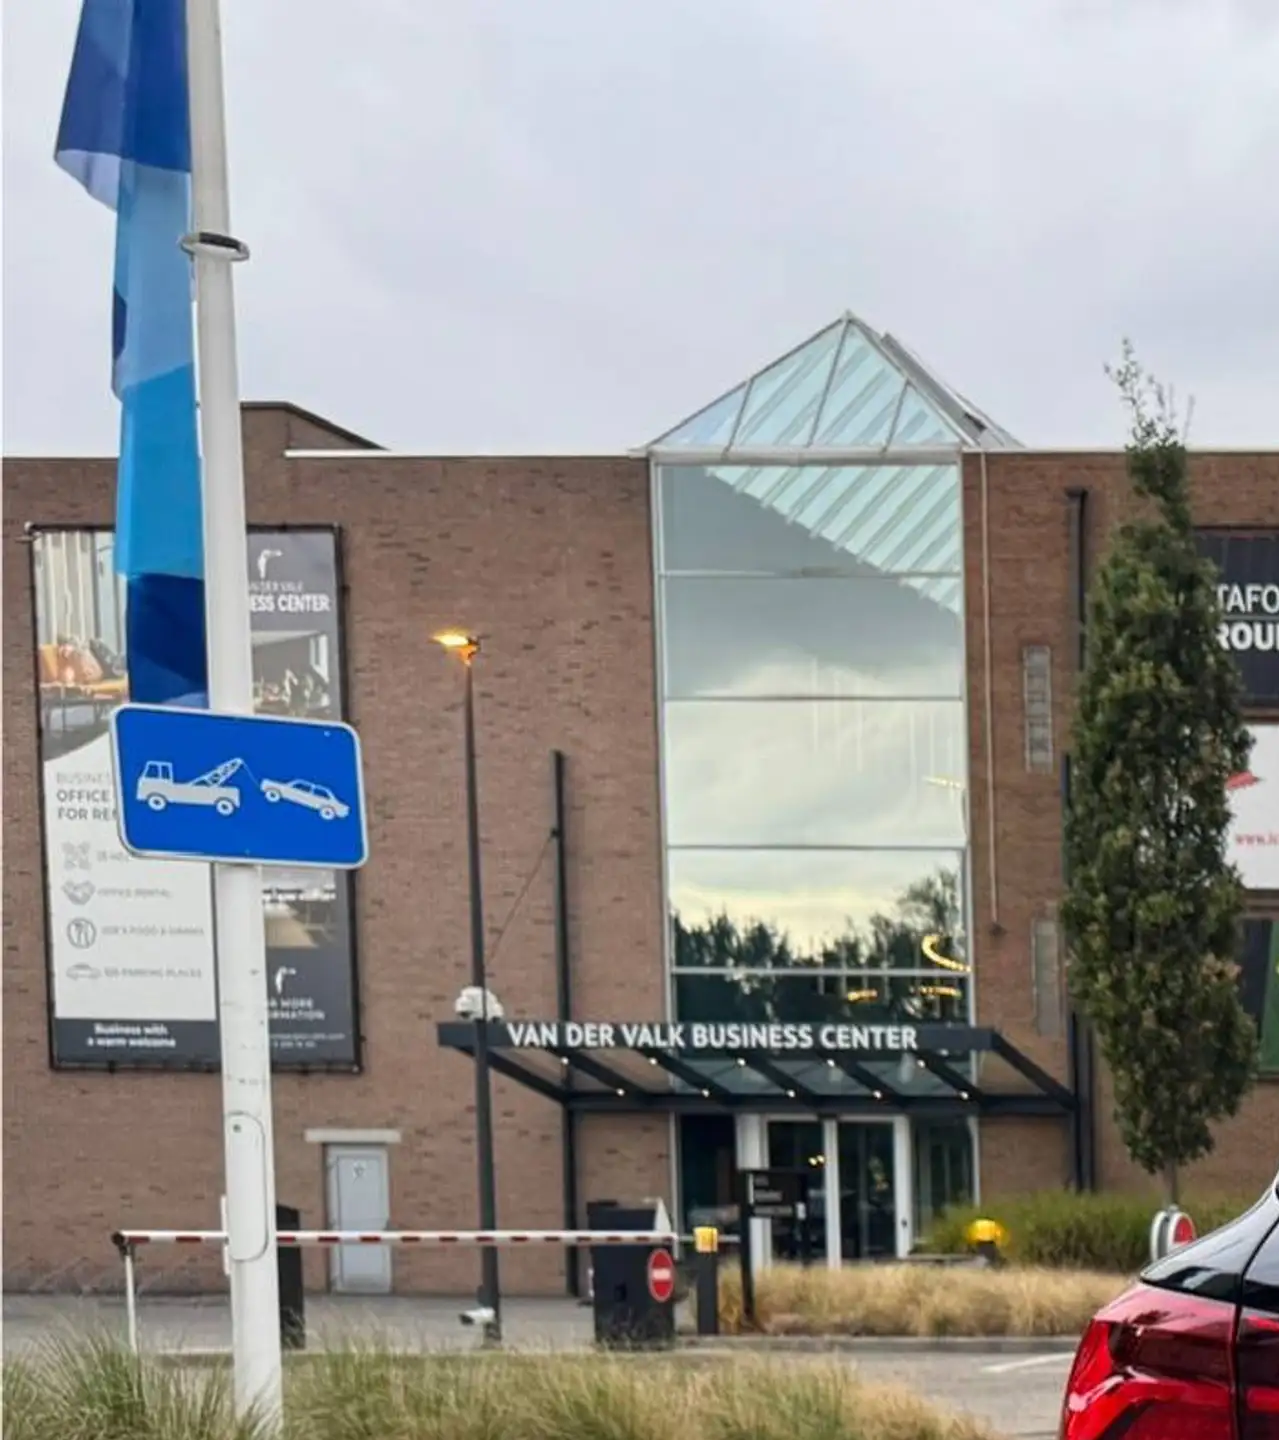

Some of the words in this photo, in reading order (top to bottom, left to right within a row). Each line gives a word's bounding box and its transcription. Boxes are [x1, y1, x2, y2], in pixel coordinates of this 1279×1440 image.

[250, 593, 275, 612] ESS
[277, 593, 332, 613] CENTER
[56, 789, 110, 804] OFFICE
[57, 806, 89, 821] FOR
[507, 1023, 558, 1047] VAN
[565, 1024, 615, 1048] DER
[621, 1024, 685, 1048] VALK
[692, 1024, 813, 1049] BUSINESS
[820, 1025, 917, 1049] CENTER
